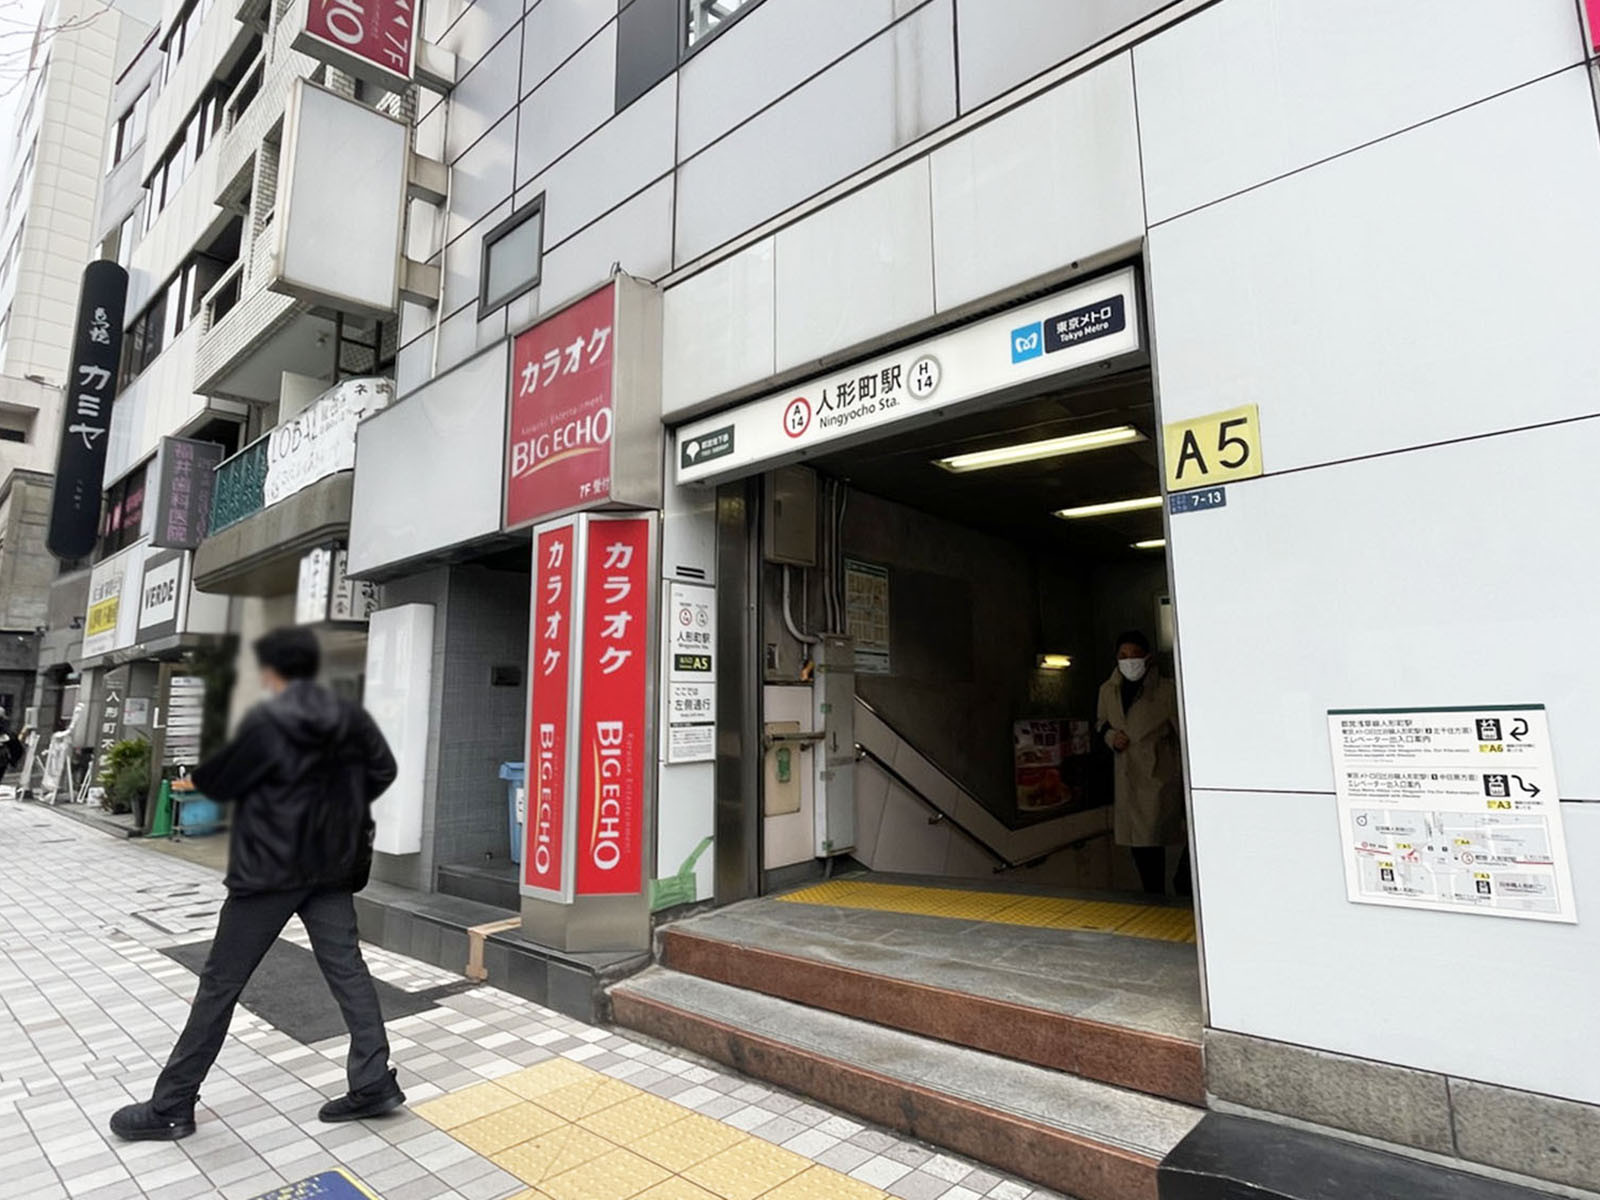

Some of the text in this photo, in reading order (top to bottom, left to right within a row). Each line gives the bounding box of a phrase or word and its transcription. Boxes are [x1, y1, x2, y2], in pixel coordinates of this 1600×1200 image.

[1056, 305, 1111, 335] 東京メトロ
[1060, 321, 1109, 344] Tokyo Metro
[519, 324, 612, 398] カラオケ
[918, 362, 929, 375] H
[815, 364, 902, 416] 人形町駅
[916, 375, 933, 392] 14
[68, 364, 111, 451] カミヤ
[793, 404, 801, 416] A
[819, 396, 900, 429] Ningyocho Sta.
[791, 415, 804, 431] 14
[512, 406, 612, 479] BIG ECHO
[1191, 491, 1222, 507] 7-13
[145, 578, 175, 610] VERDE
[543, 540, 564, 677] カラオケ
[600, 541, 634, 674] カラオケ
[677, 630, 711, 644] 人形町駅
[693, 657, 709, 670] A5
[1489, 744, 1504, 753] A6
[534, 723, 555, 875] BIG ECHO
[593, 721, 623, 870] BIG ECHO
[1497, 800, 1512, 809] A3
